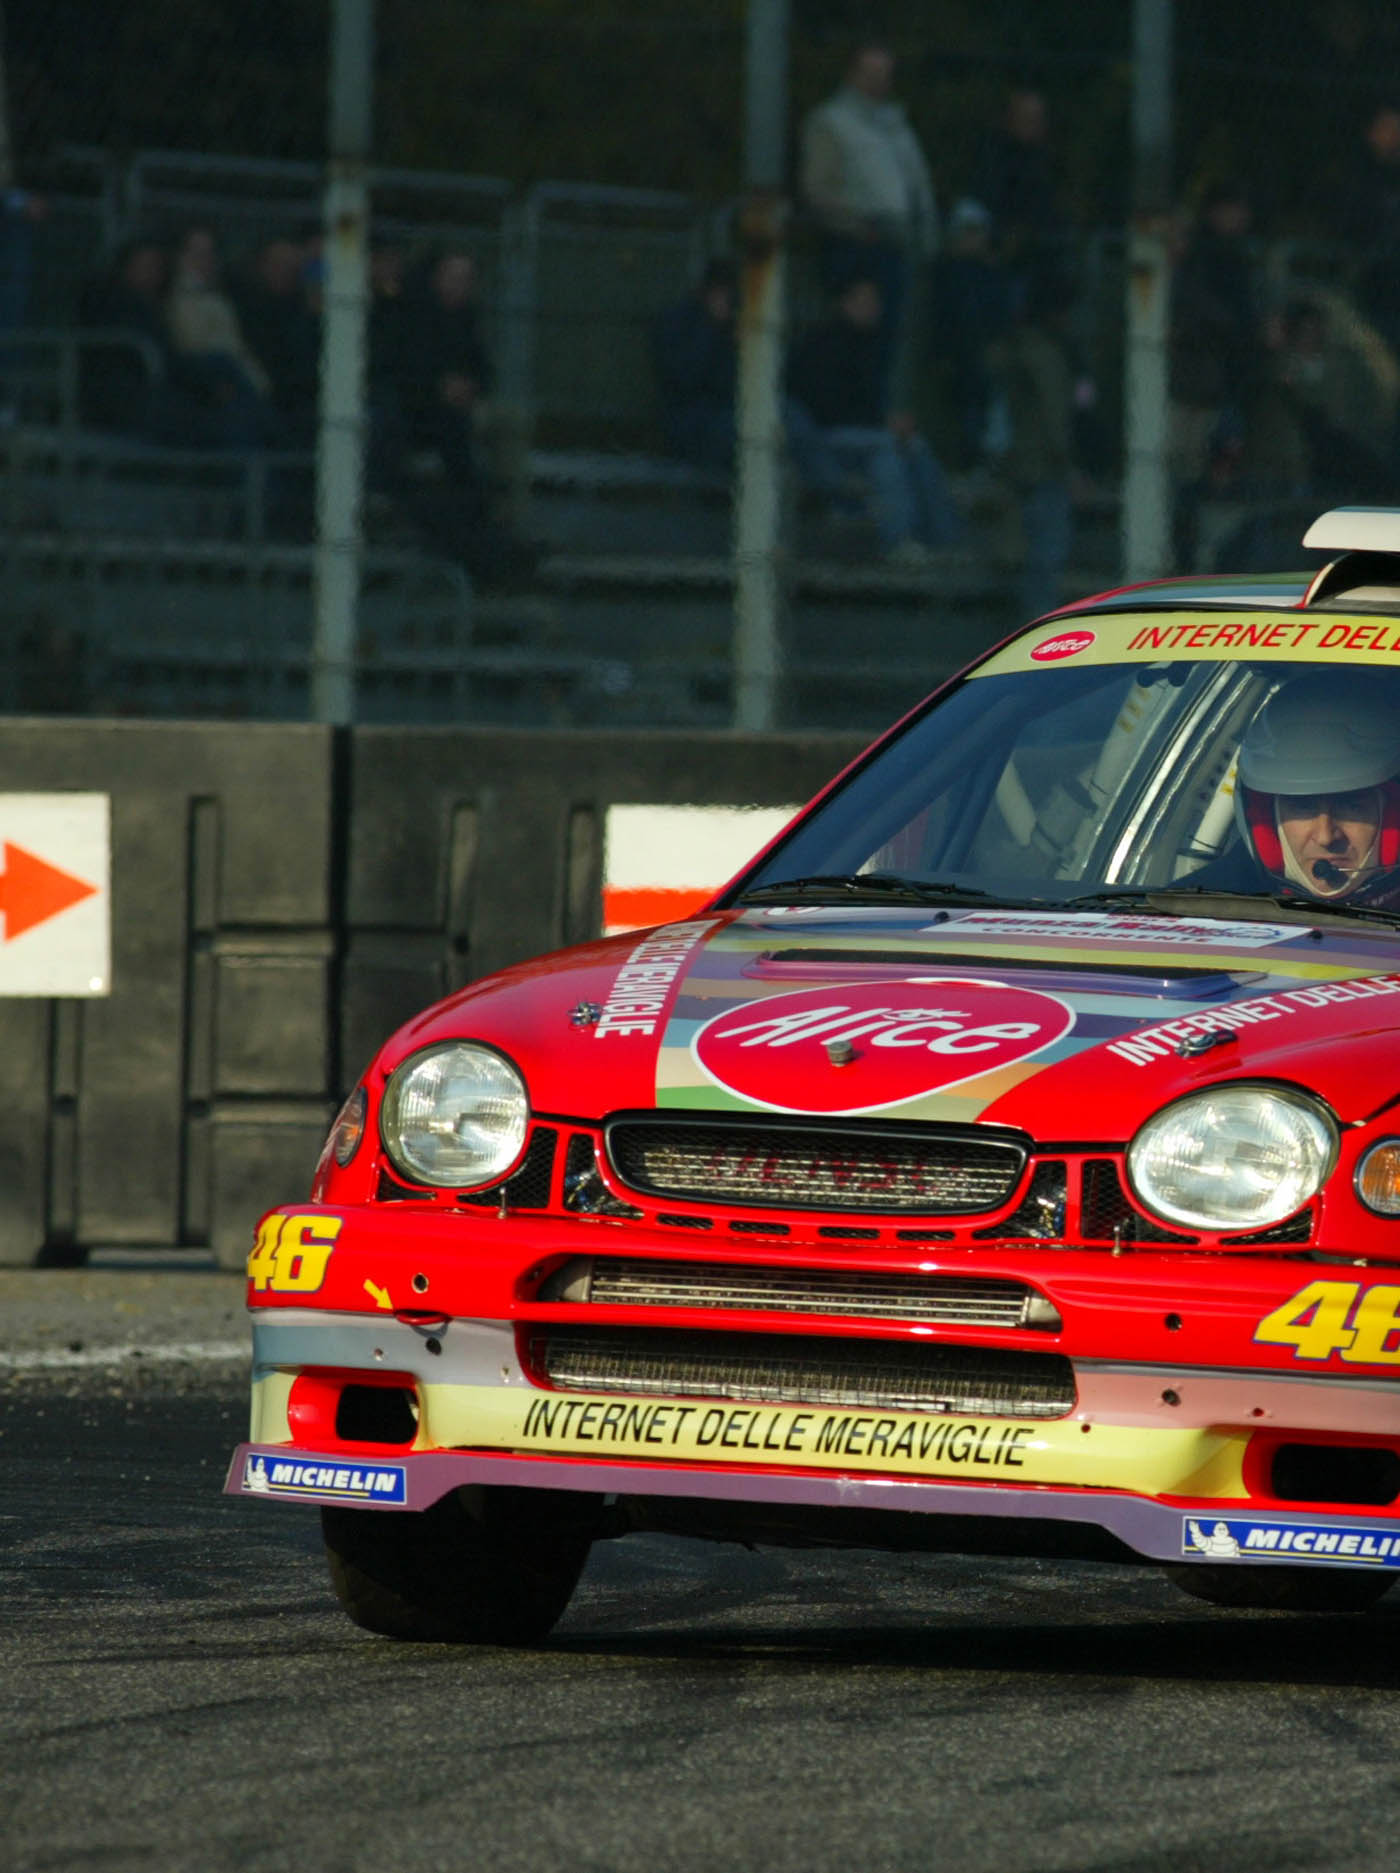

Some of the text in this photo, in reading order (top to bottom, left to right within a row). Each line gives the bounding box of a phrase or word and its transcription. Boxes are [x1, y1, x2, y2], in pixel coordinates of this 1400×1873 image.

[1127, 623, 1319, 650] INTERNET
[594, 962, 682, 1038] MERAVIGLIE
[715, 1006, 1042, 1055] Alice
[1106, 996, 1296, 1067] INTERNET
[248, 1213, 343, 1294] 46
[523, 1400, 1035, 1467] INTERNET DELLE MERAVIGLIE
[271, 1463, 397, 1493] MICHELIN
